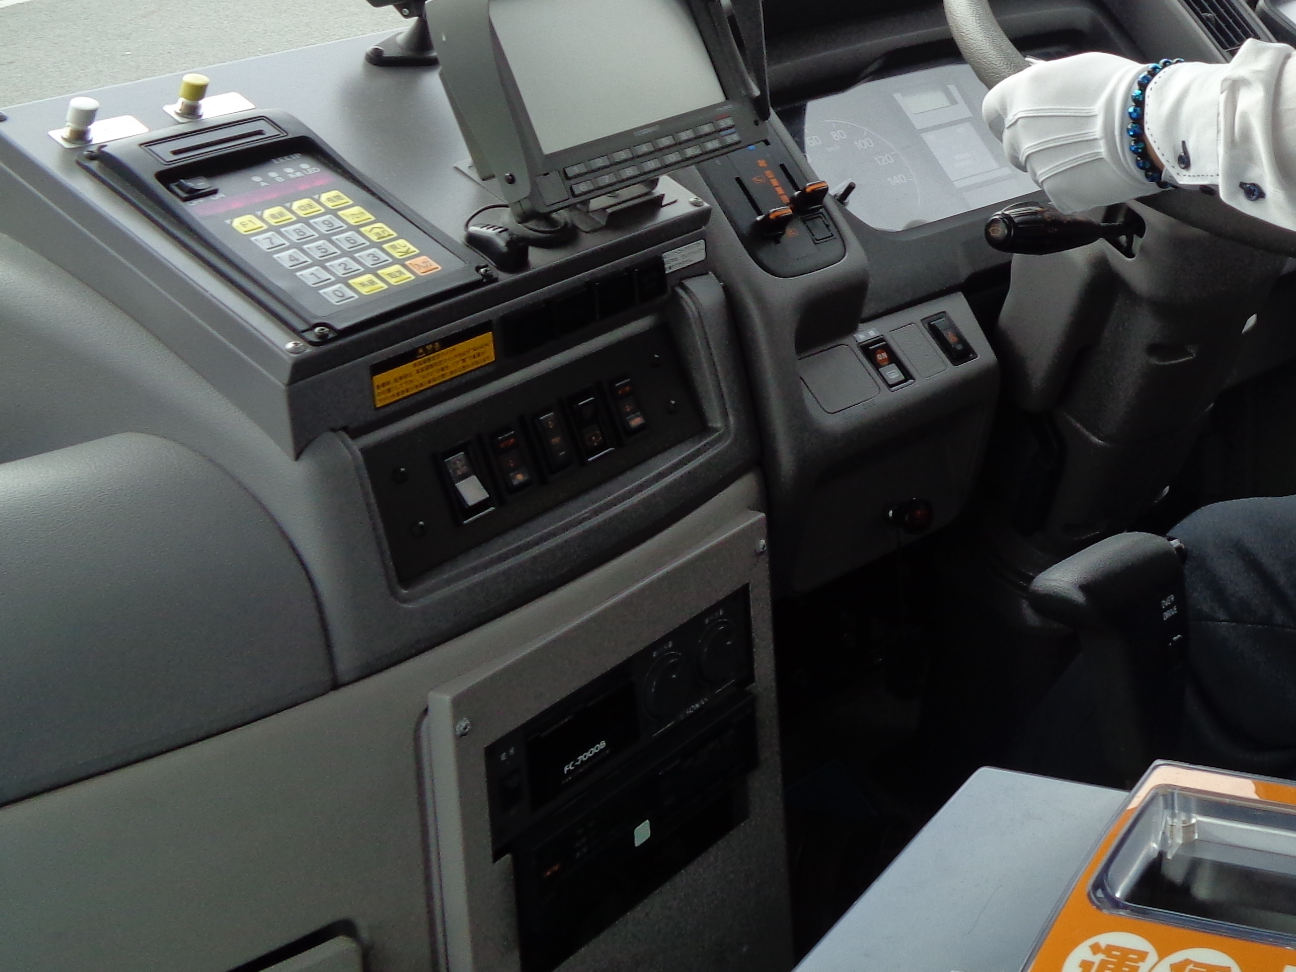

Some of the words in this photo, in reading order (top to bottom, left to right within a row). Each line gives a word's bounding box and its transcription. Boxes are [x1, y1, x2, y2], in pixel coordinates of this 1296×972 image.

[830, 130, 847, 141] 80
[854, 137, 875, 150] 100
[874, 153, 894, 166] 120
[887, 173, 907, 186] 140
[322, 219, 333, 228] 9
[293, 228, 306, 237] 8
[263, 236, 274, 245] 7
[344, 236, 356, 245] 6
[315, 245, 328, 254] 5
[288, 254, 299, 262] 4
[367, 253, 380, 262] 3
[338, 262, 351, 271] 2
[309, 272, 321, 280] 1
[332, 289, 345, 298] 0
[876, 352, 888, 360] ON
